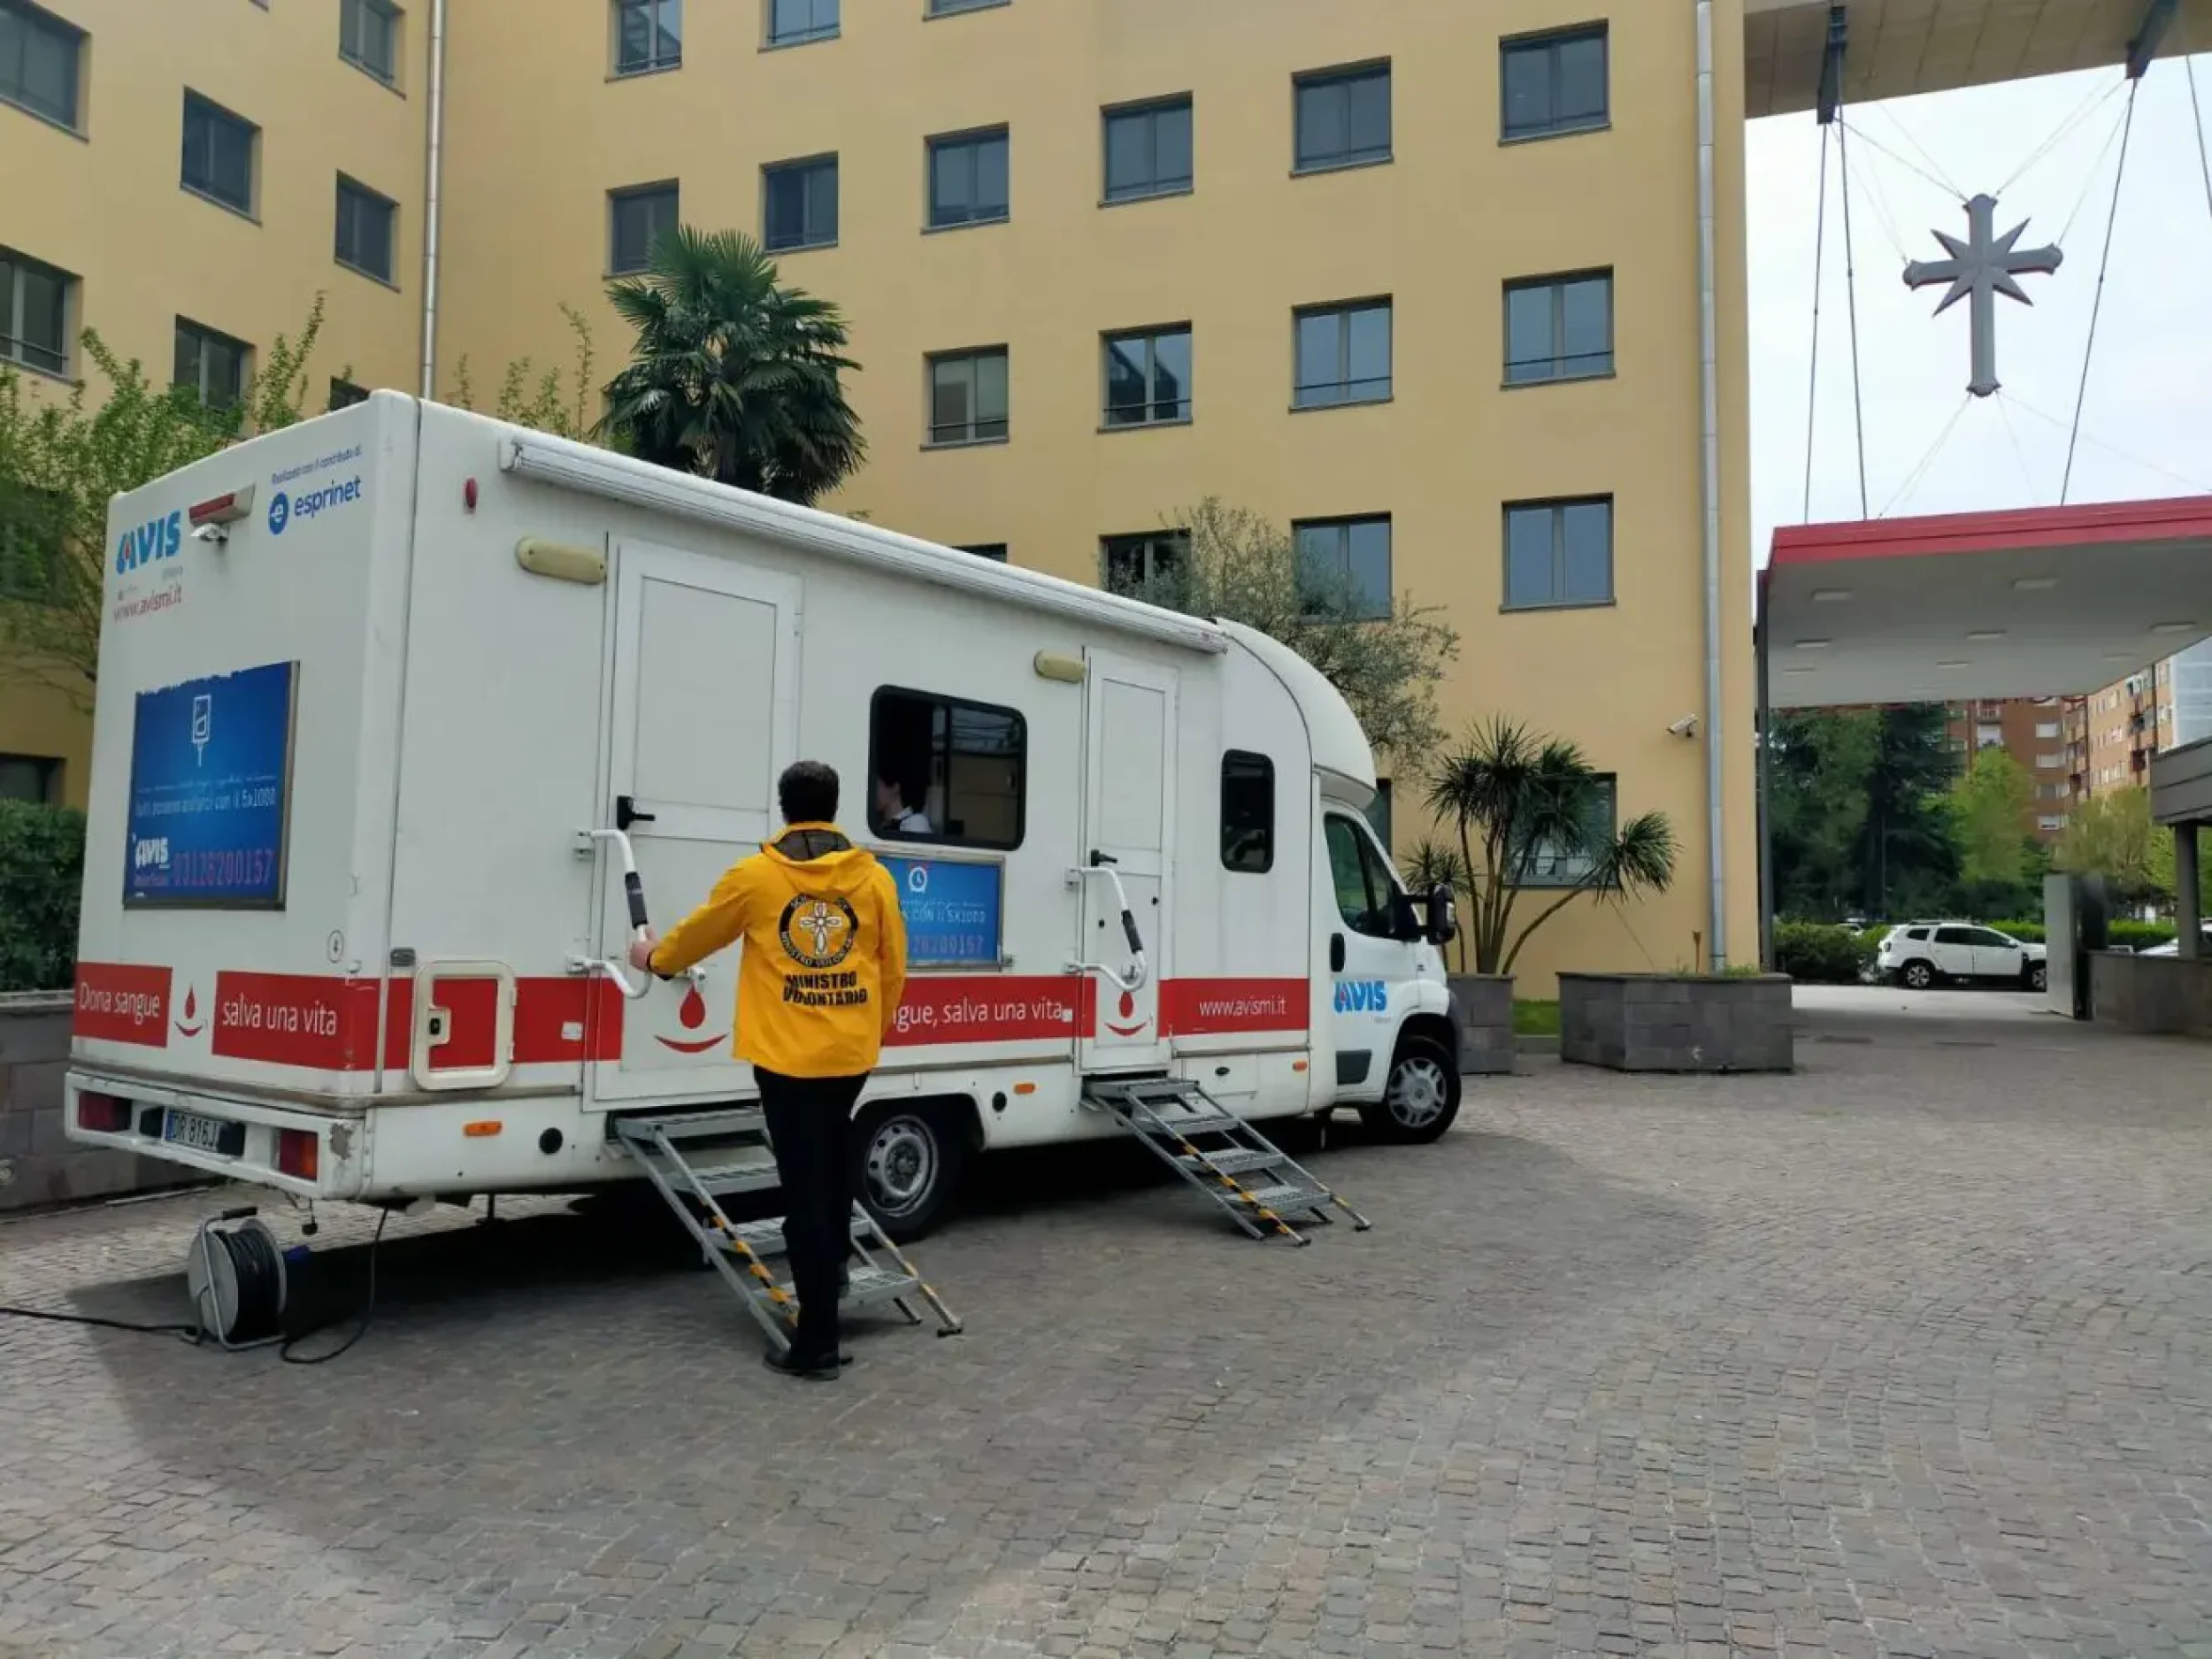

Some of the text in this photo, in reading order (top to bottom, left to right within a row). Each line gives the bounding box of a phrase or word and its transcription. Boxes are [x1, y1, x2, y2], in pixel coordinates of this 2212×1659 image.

[295, 475, 361, 519] esprinet
[116, 510, 180, 575] AVIS
[785, 972, 856, 989] MINISTRO
[1333, 979, 1387, 1013] AVIS
[79, 981, 160, 1025] Dona sangue
[222, 991, 336, 1036] salva una vita
[893, 995, 1062, 1033] gue, salva una vita
[1199, 993, 1287, 1017] www.avismi.it
